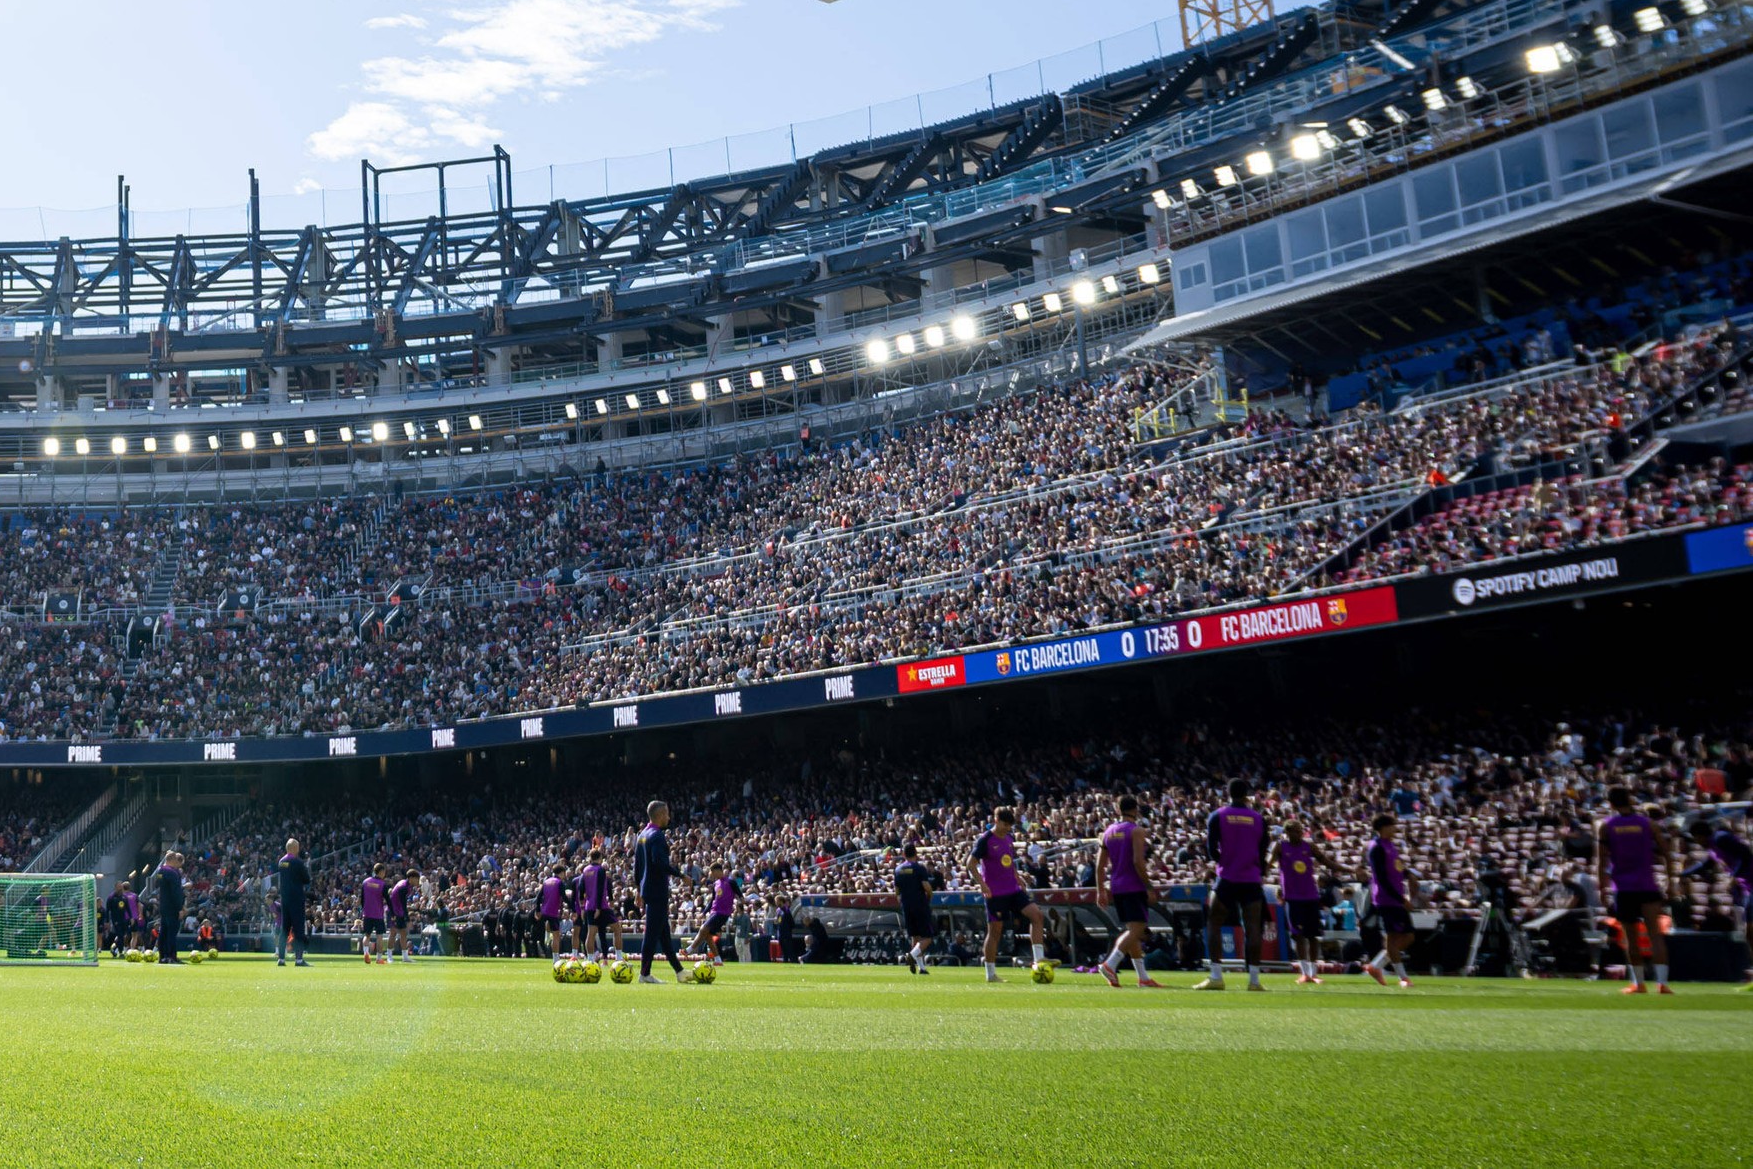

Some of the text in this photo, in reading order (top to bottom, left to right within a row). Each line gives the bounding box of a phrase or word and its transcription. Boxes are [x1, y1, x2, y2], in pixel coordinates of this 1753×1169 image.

[1475, 557, 1619, 598] SPOTIFY CAMP NOU
[1015, 601, 1323, 674] FC BARCELONA 0 17:35 0 FC BARCELONA
[918, 664, 956, 681] ESTRELLA
[825, 675, 854, 701] PRIME
[715, 691, 742, 715] PRIME
[614, 705, 638, 727] PRIME
[432, 728, 455, 748] PRIME
[521, 717, 544, 738] PRIME
[68, 746, 102, 763] PRIME
[204, 743, 236, 760] PRIME
[329, 737, 357, 756] PRIME
